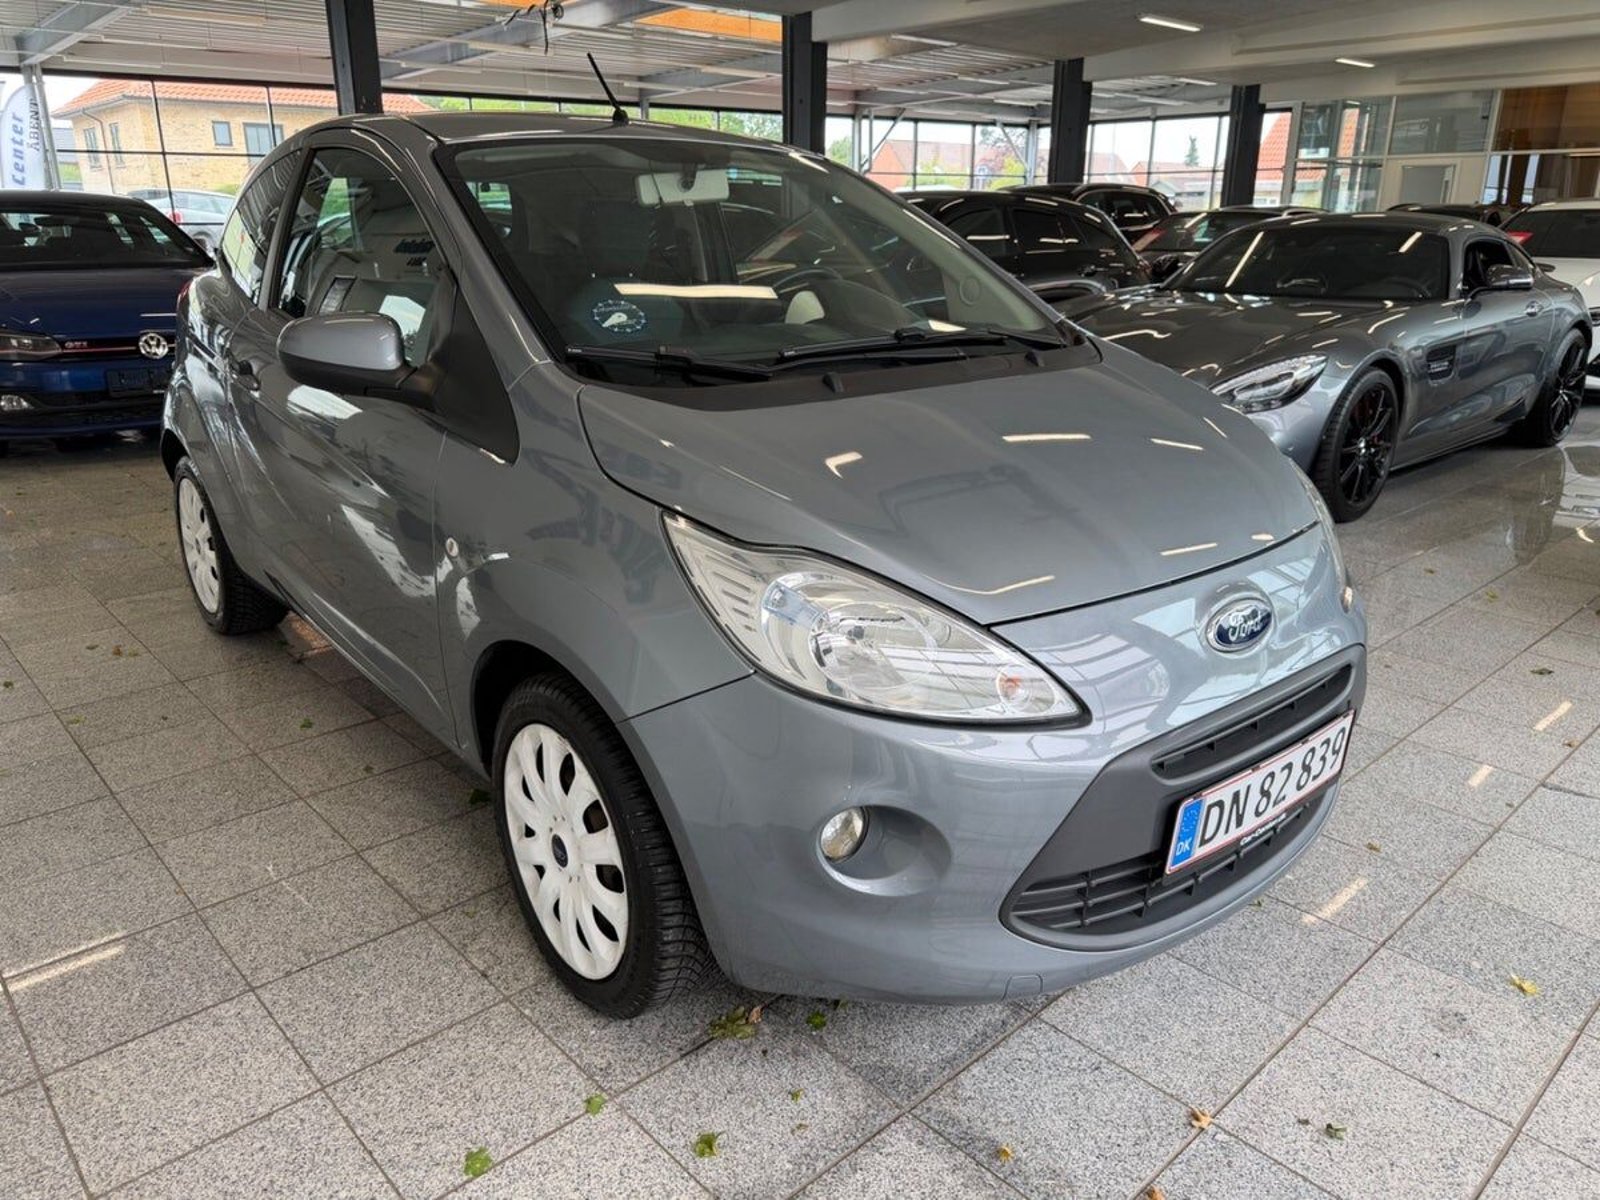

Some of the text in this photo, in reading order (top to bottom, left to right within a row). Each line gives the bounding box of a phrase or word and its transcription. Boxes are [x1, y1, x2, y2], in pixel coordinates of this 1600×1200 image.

[64, 341, 88, 349] GTI
[1228, 605, 1263, 642] Ford
[1198, 726, 1347, 849] DN 82 839
[1175, 837, 1193, 857] DK
